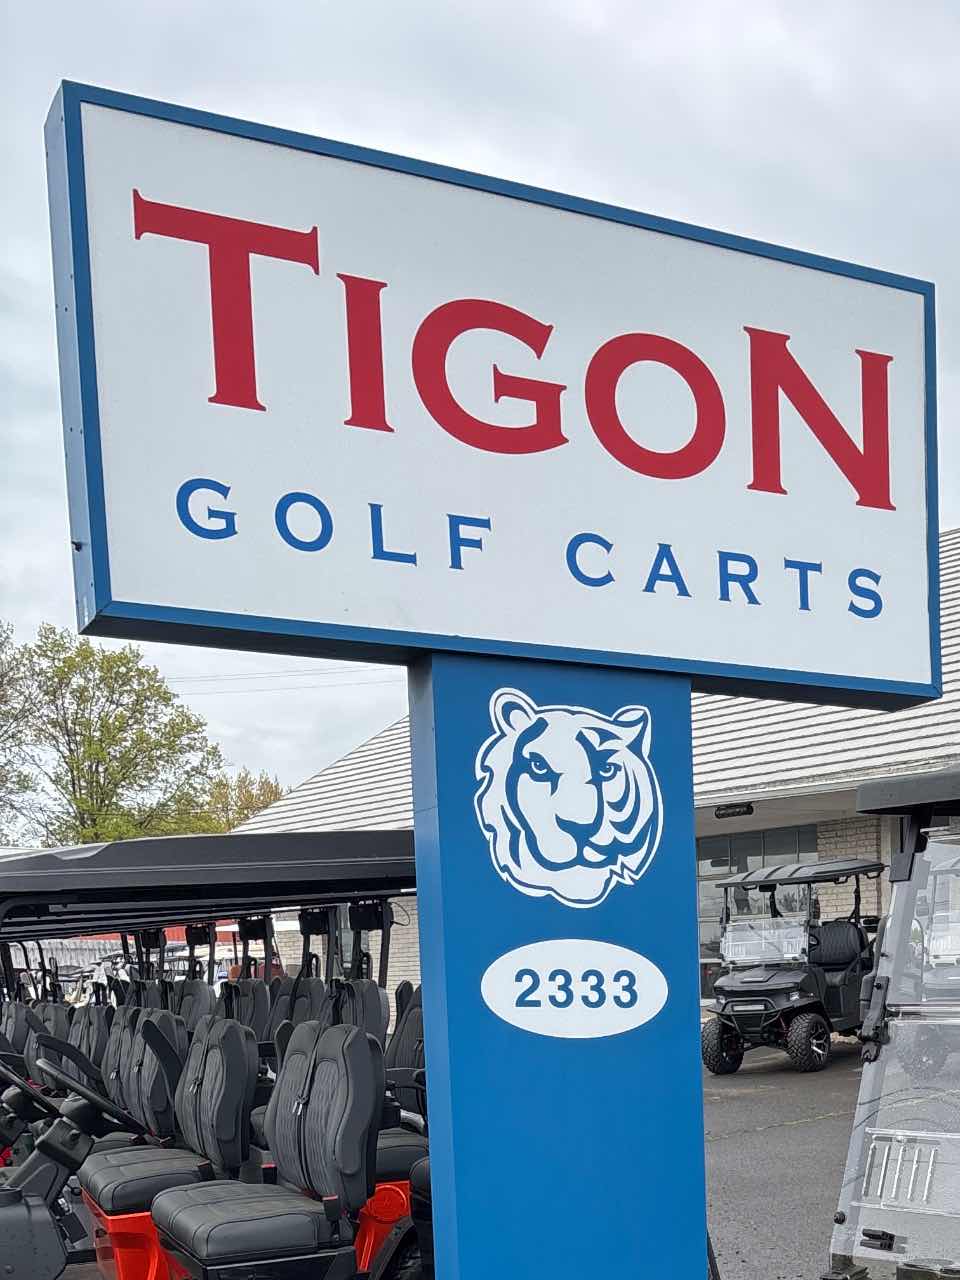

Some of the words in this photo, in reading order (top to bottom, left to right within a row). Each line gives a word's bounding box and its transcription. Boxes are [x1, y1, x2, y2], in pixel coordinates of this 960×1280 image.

[133, 188, 897, 511] TIGON
[175, 477, 492, 570] GOLF
[565, 531, 884, 619] CARTS
[514, 968, 638, 1009] 2333
